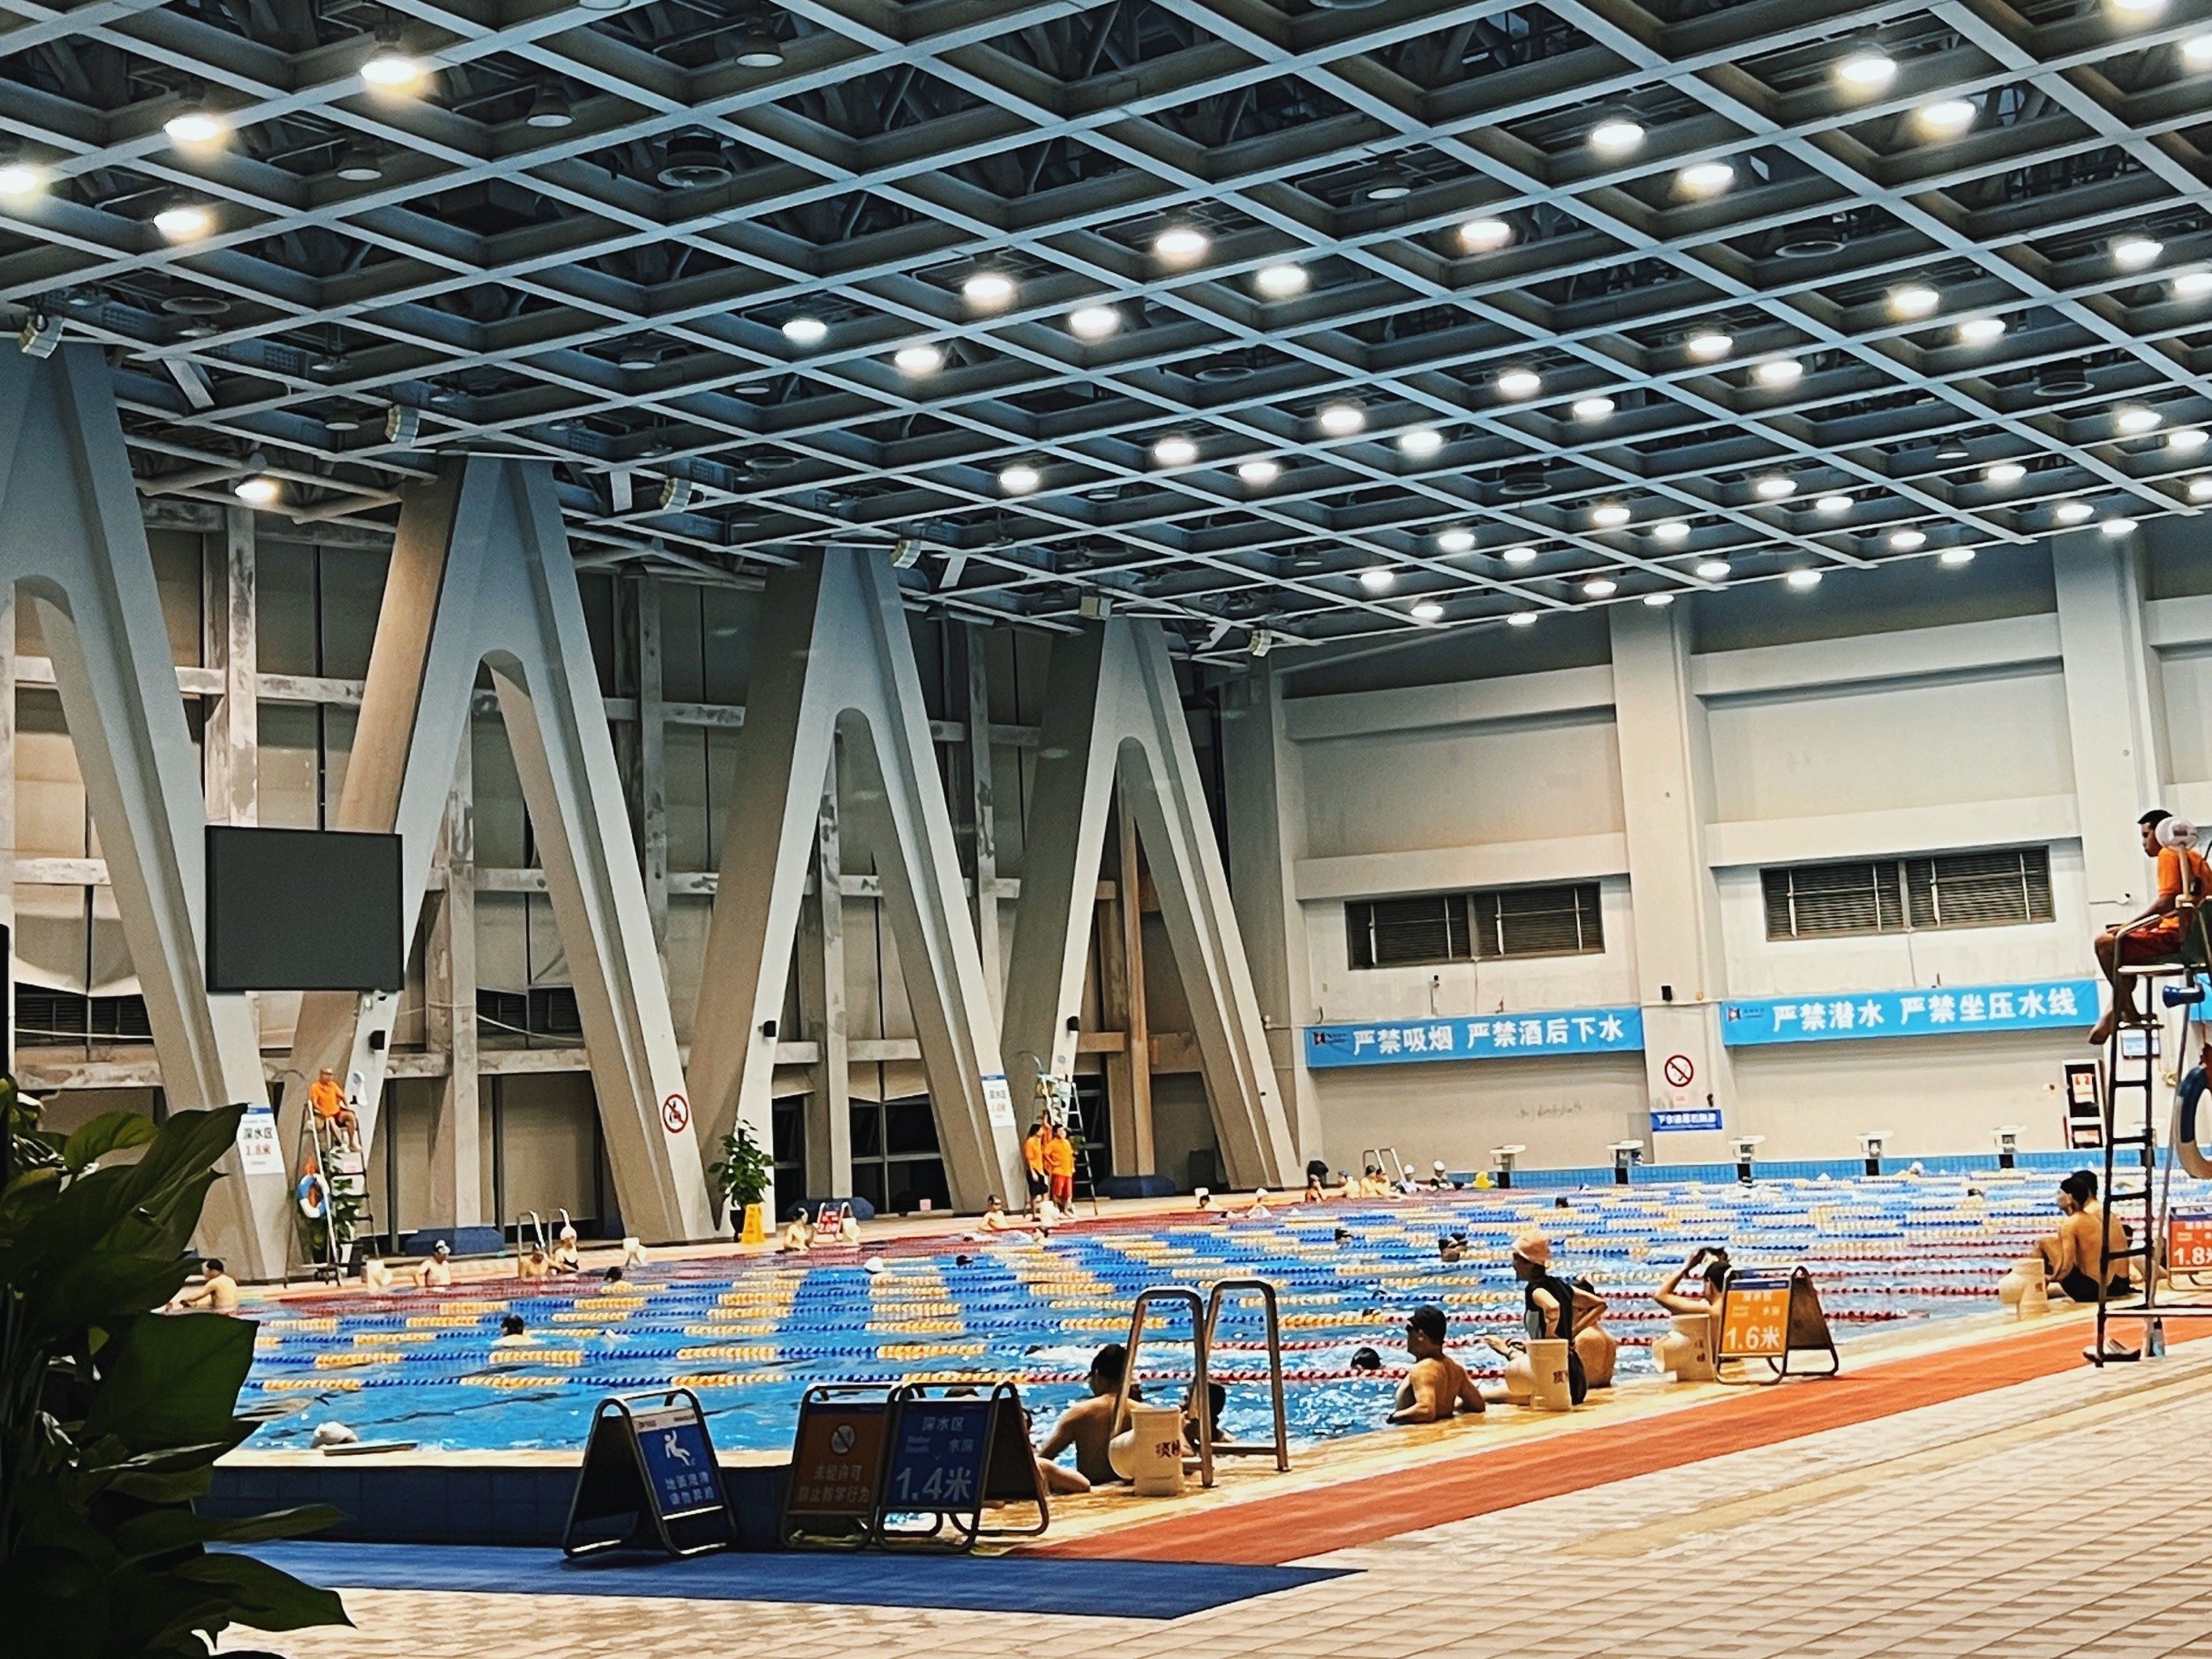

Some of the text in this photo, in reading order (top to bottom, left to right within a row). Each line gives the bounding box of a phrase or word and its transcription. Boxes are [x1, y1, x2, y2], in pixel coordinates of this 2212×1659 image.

[1773, 987, 2077, 1032] 严禁潜水 严禁坐压水线
[1352, 1014, 1624, 1056] 严禁吸烟 严禁酒后下水
[1726, 1324, 1780, 1350] 1.6米
[921, 1416, 965, 1431] 深水区
[895, 1466, 971, 1502] 1.4米
